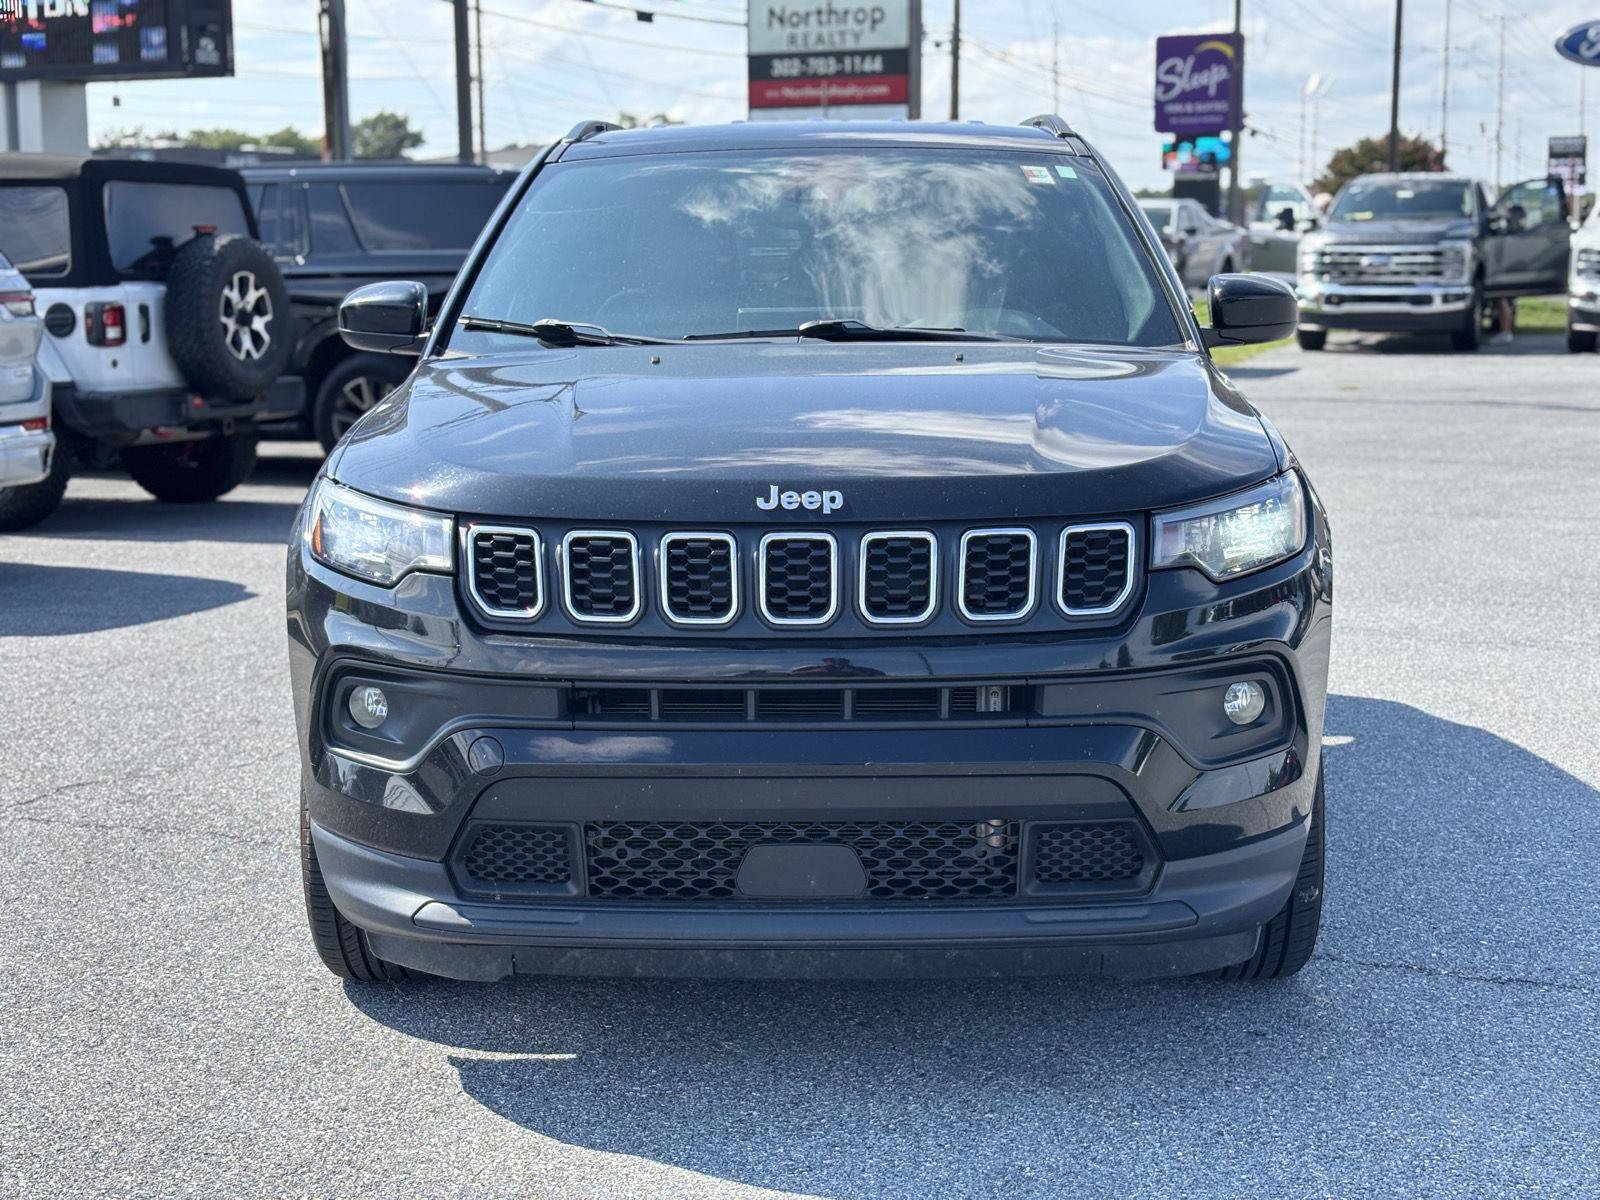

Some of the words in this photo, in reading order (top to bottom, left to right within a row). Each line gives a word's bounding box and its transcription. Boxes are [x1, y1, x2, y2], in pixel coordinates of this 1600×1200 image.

[767, 5, 886, 30] Northrop
[786, 31, 864, 48] REALTY
[756, 484, 844, 515] Jeep
